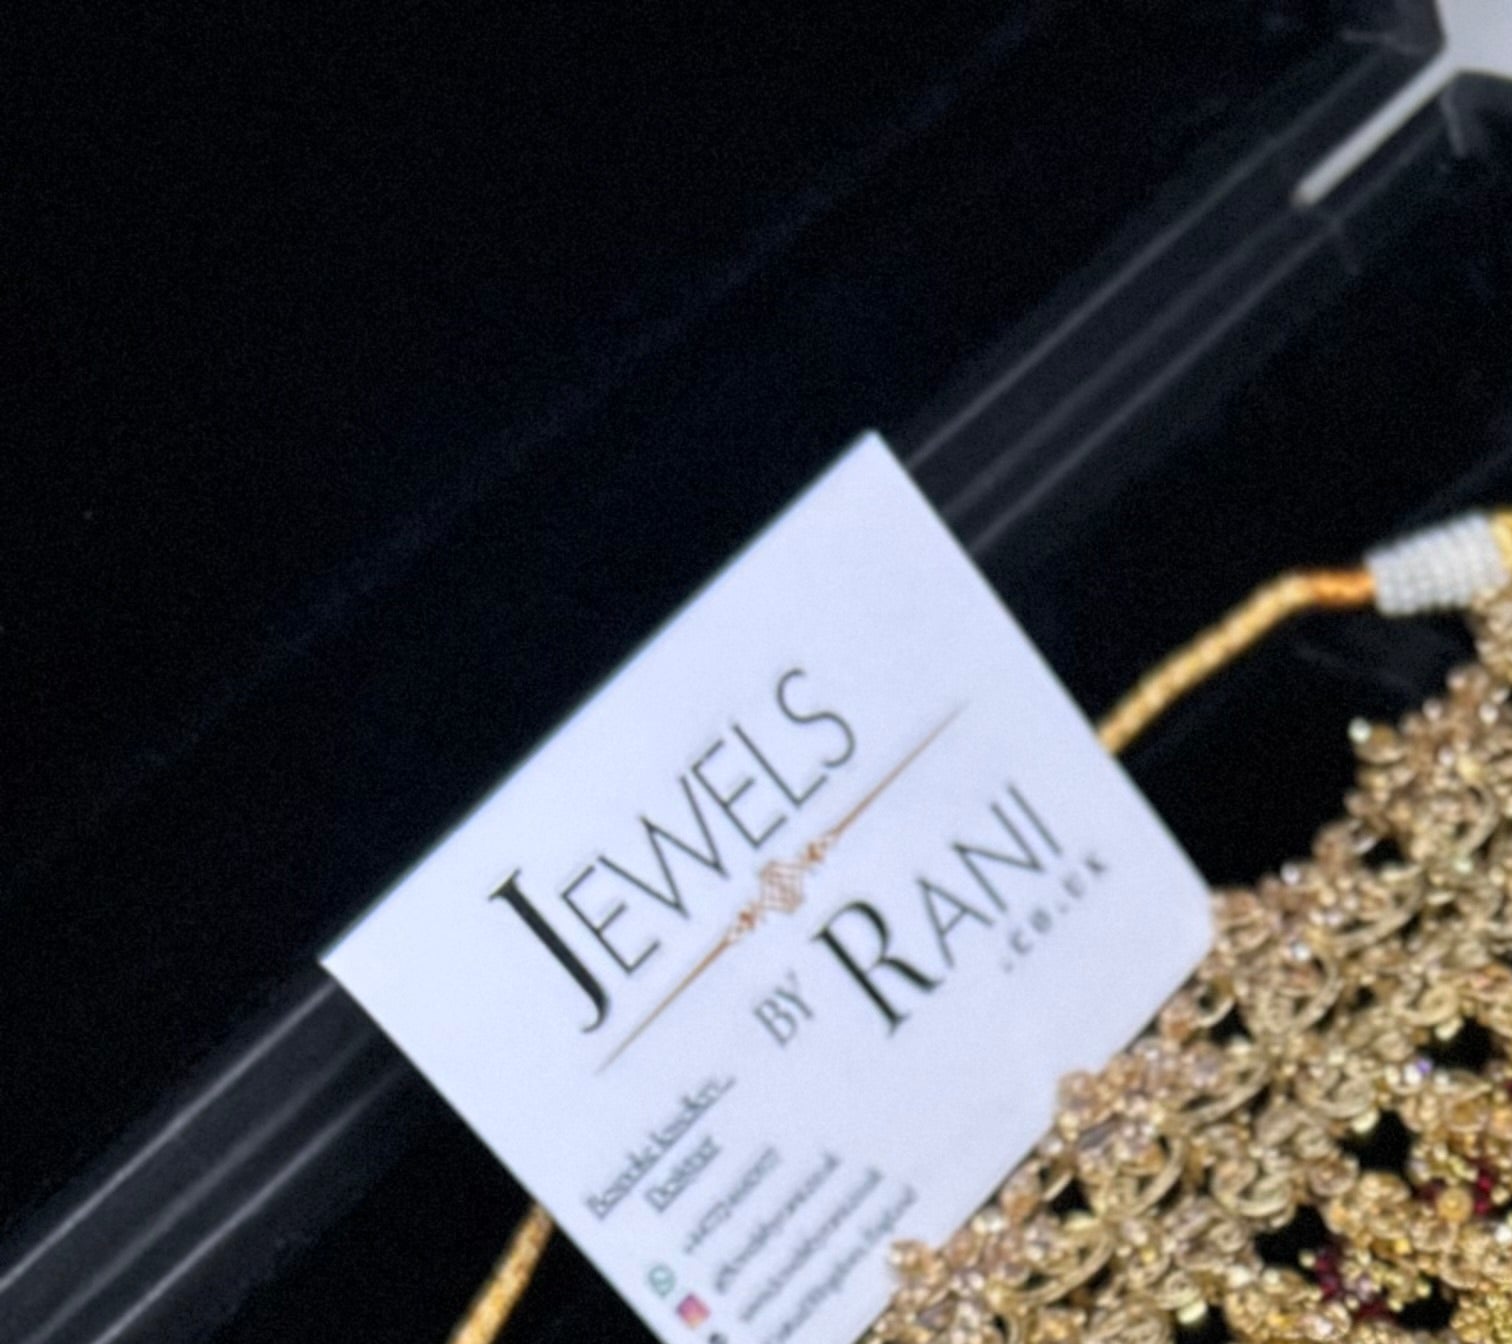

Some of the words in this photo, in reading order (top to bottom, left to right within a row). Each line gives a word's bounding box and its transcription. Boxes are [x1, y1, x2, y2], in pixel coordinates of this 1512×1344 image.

[488, 667, 856, 1034] JEWELS
[752, 969, 815, 1048] BY
[808, 783, 1064, 1041] RANI
